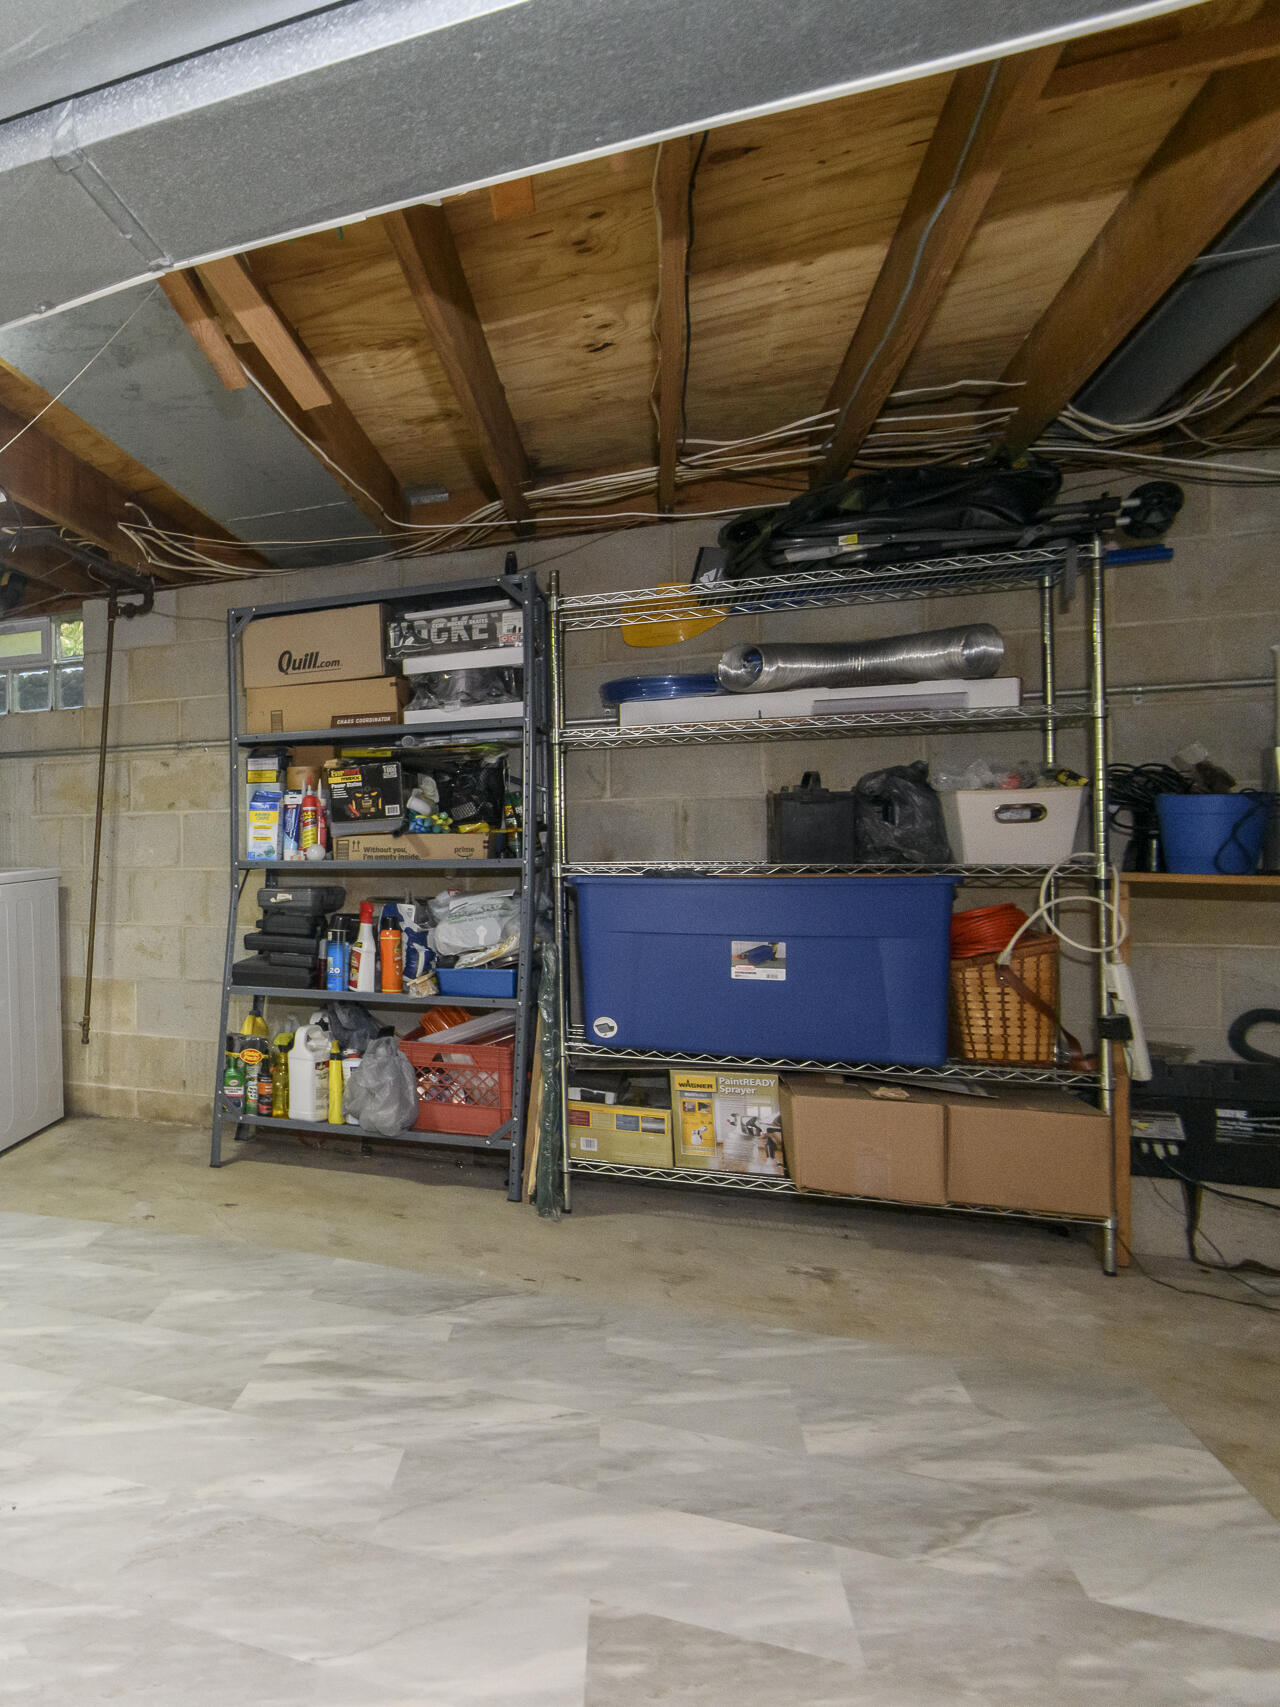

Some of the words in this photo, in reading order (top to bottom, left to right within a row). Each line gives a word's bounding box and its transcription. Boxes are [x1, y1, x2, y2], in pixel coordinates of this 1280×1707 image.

[278, 650, 340, 675] Quill.com
[355, 716, 391, 724] COORDINATOR
[392, 847, 408, 855] you,
[454, 846, 475, 854] prime
[678, 1080, 713, 1089] WAGNER
[719, 1077, 776, 1087] PaintREADY
[719, 1085, 756, 1095] Sprayer
